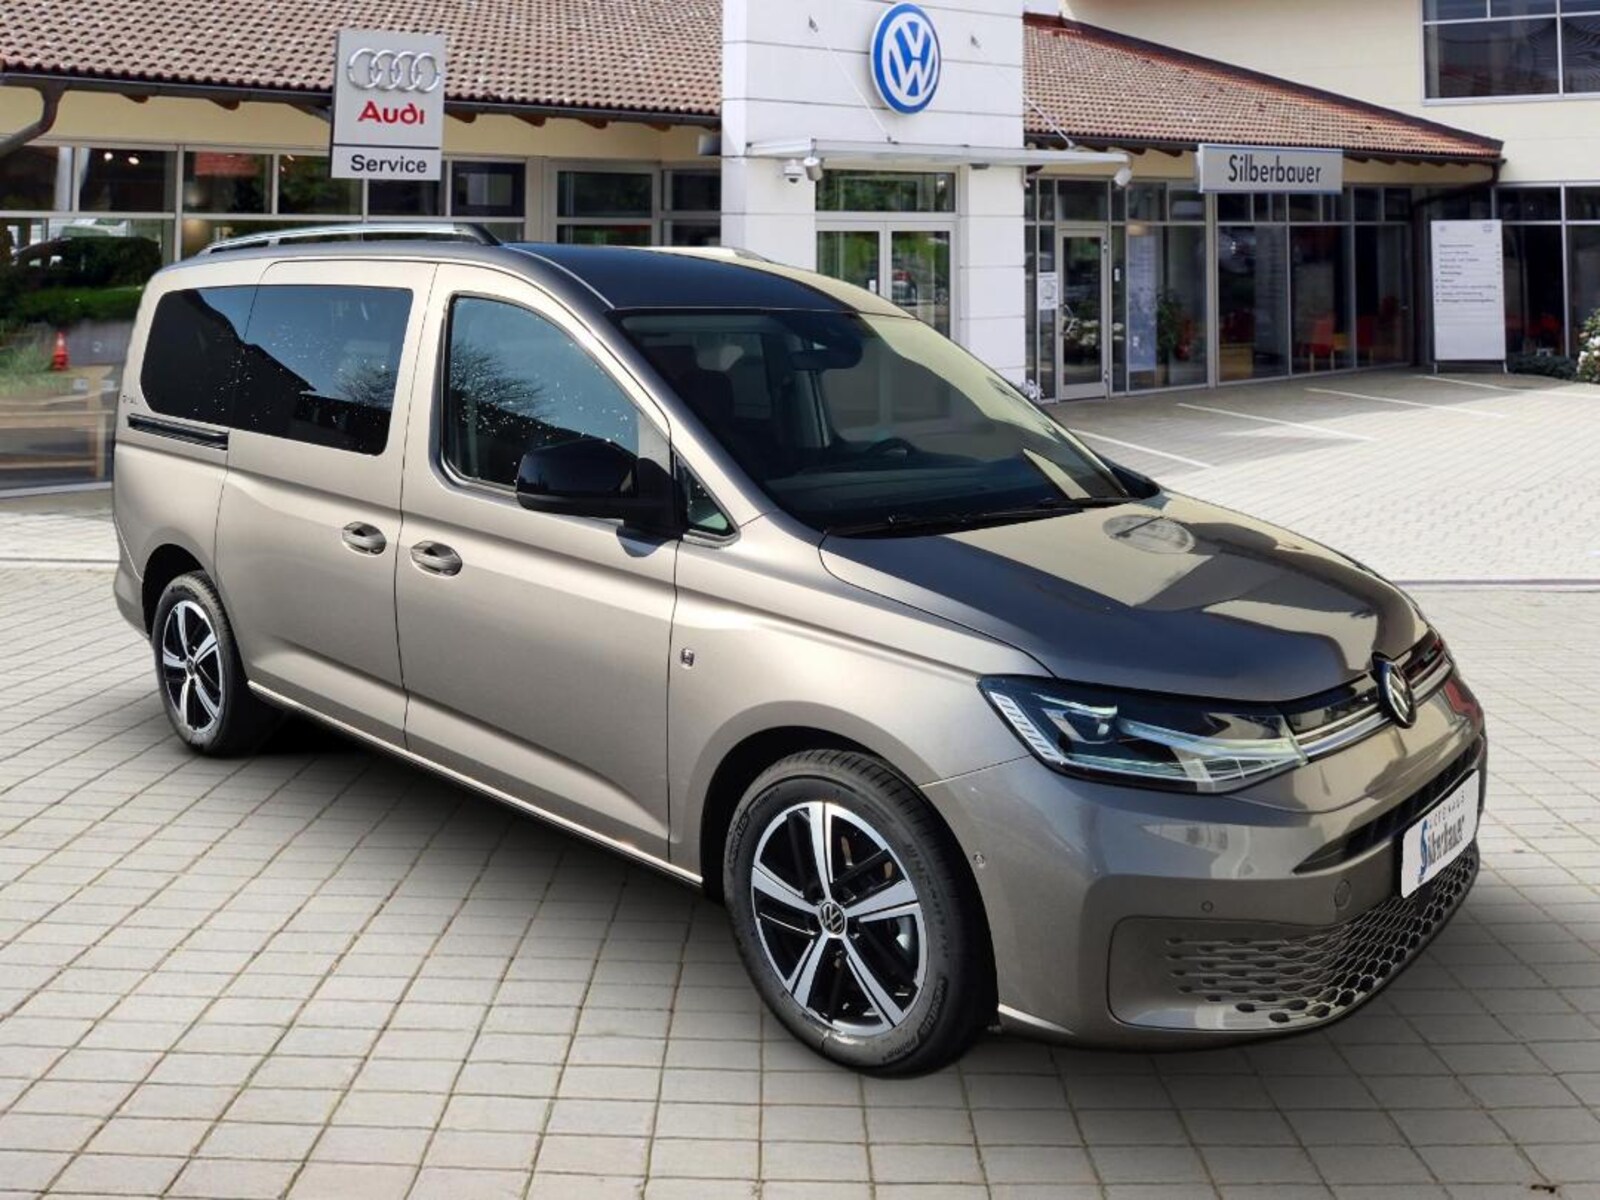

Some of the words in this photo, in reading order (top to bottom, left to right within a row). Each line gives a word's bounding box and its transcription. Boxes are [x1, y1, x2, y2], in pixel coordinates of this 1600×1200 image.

[357, 100, 425, 125] Audi
[350, 154, 428, 173] Service
[1227, 153, 1321, 183] Silberbauer
